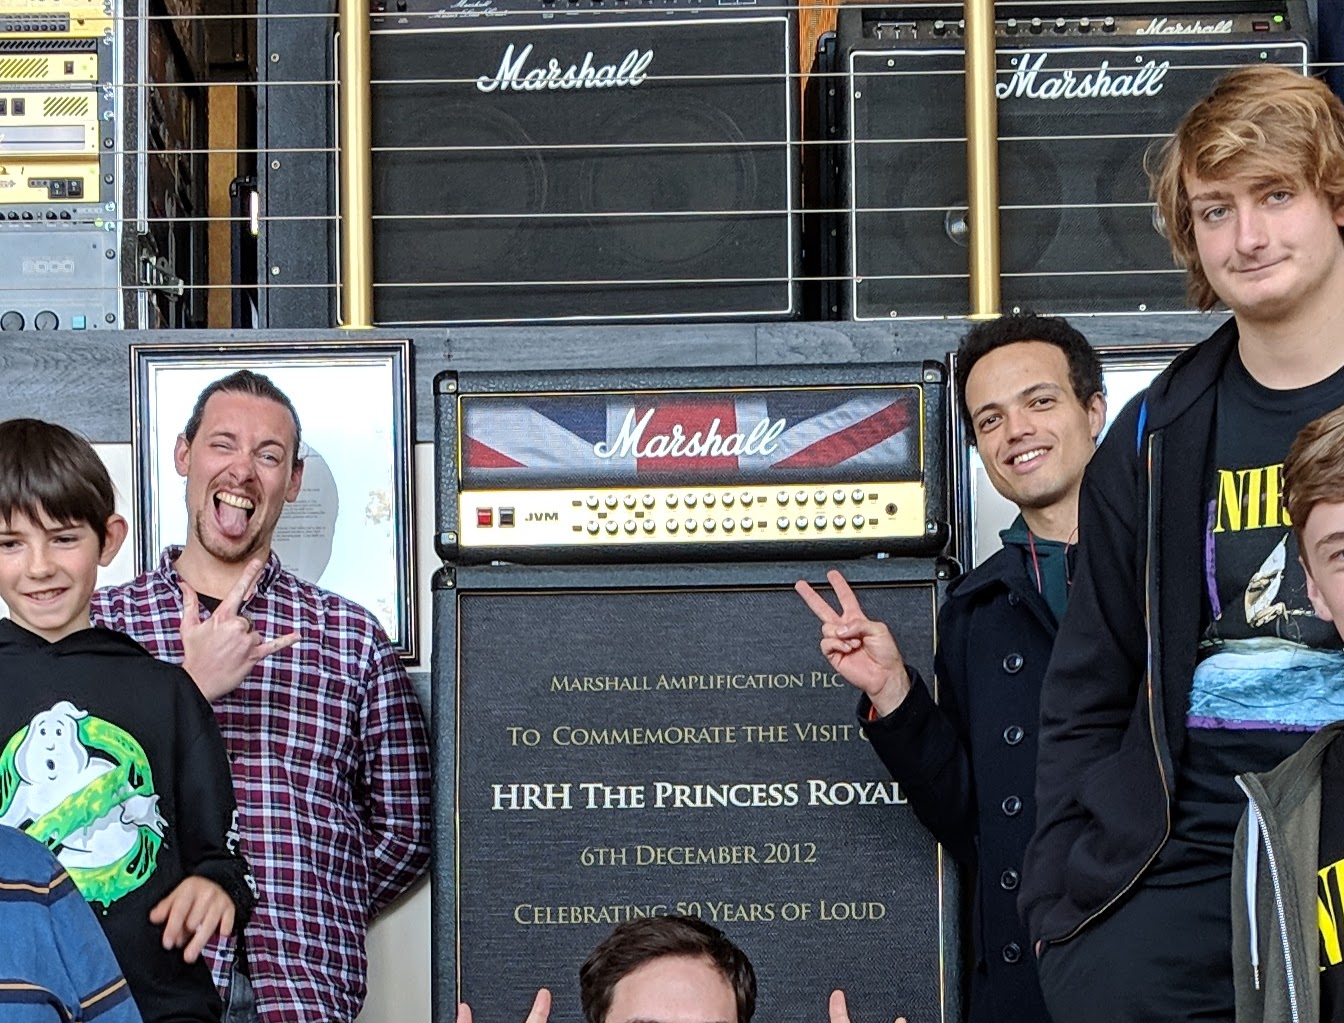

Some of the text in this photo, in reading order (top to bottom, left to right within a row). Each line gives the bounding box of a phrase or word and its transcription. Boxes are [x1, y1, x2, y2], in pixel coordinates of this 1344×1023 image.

[1135, 17, 1233, 35] Marshall
[476, 43, 654, 93] Marshall
[996, 52, 1170, 100] Marshall
[593, 408, 787, 460] Marshall
[1213, 463, 1293, 533] NIR
[524, 512, 558, 521] JVM
[551, 671, 845, 692] MARSHALL AMPLIFICATION PLC
[507, 726, 541, 747] TO
[552, 724, 737, 746] COMMEMORATE
[740, 724, 790, 744] THE
[793, 722, 854, 742] VISIT
[491, 779, 908, 810] HRH THE PRINCESS ROYAL
[580, 842, 817, 867] 6TH DECEMBER 2012
[676, 901, 702, 919] 50
[706, 901, 774, 922] YEARS
[781, 902, 812, 921] OF
[819, 900, 886, 920] LOUD
